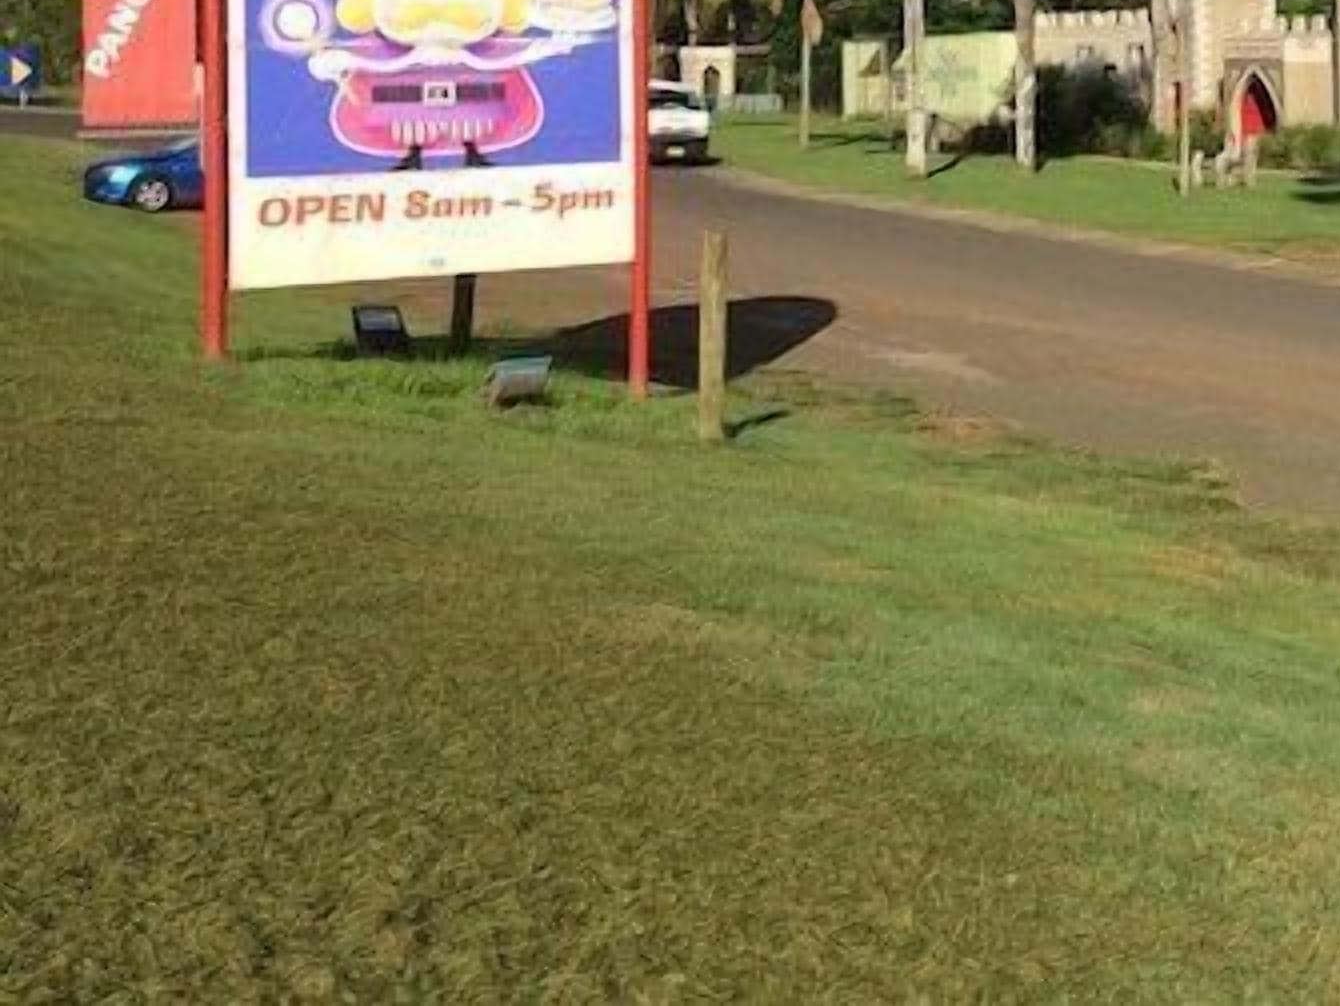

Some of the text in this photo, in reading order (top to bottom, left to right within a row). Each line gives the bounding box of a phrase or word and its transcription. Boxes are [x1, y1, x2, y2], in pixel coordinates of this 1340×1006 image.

[258, 191, 386, 227] OPEN
[404, 189, 493, 220] 8am
[531, 181, 615, 219] 5pm
